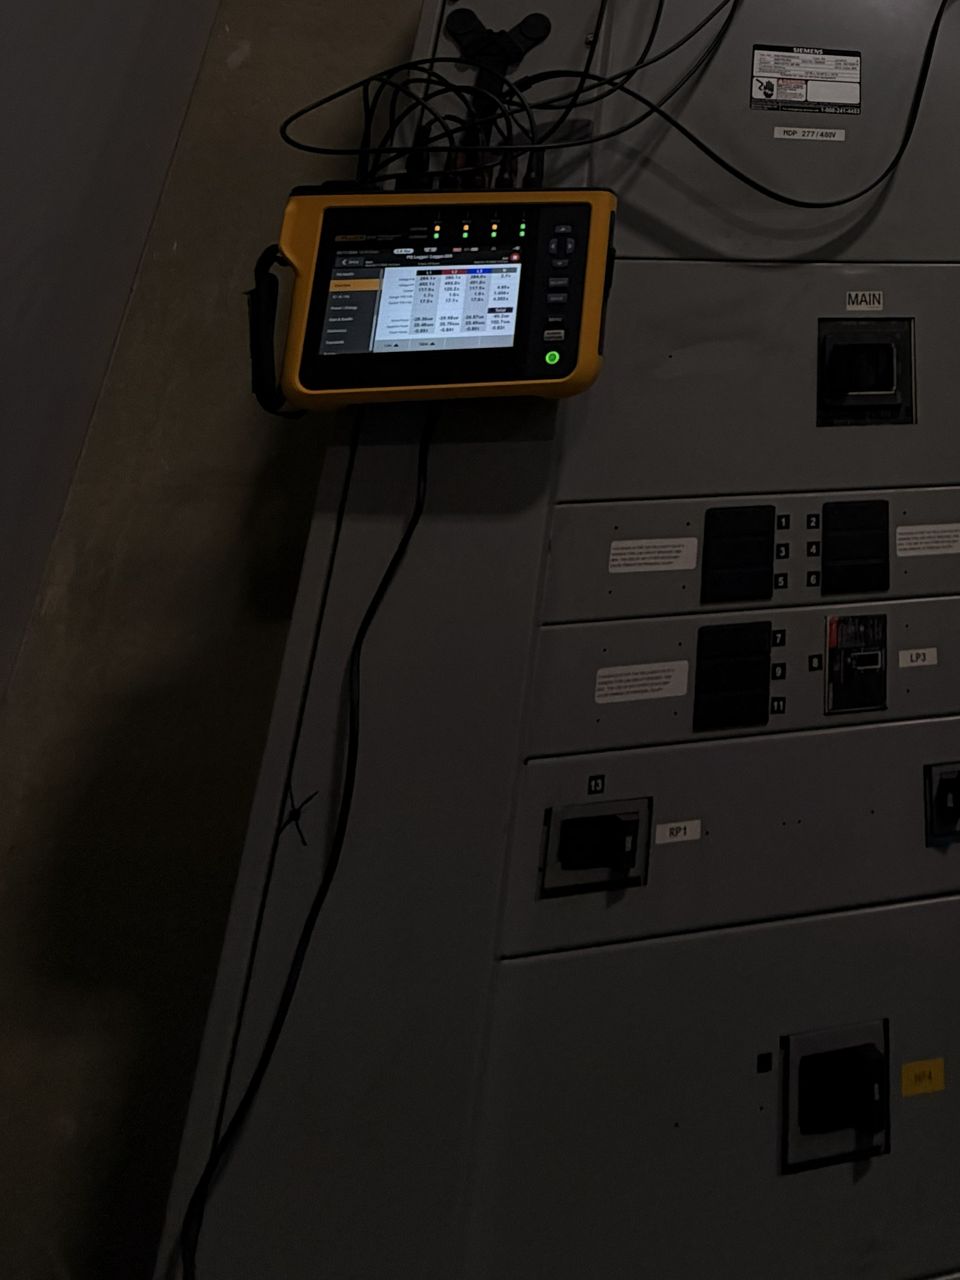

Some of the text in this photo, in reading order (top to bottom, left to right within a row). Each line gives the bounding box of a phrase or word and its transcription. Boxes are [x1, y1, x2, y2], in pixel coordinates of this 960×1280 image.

[793, 47, 824, 55] SIEMENS
[783, 129, 837, 138] MDP 277/480V
[848, 293, 881, 306] MAIN
[780, 516, 786, 527] 1
[809, 516, 817, 527] 2
[778, 545, 786, 557] 3
[809, 543, 817, 555] 4
[777, 575, 785, 587] 5
[809, 573, 817, 585] 6
[775, 632, 782, 644] 7
[910, 651, 927, 663] LP3
[774, 665, 782, 678] 9
[772, 699, 784, 712] 11
[590, 778, 603, 792] 13
[669, 824, 688, 838] RP1
